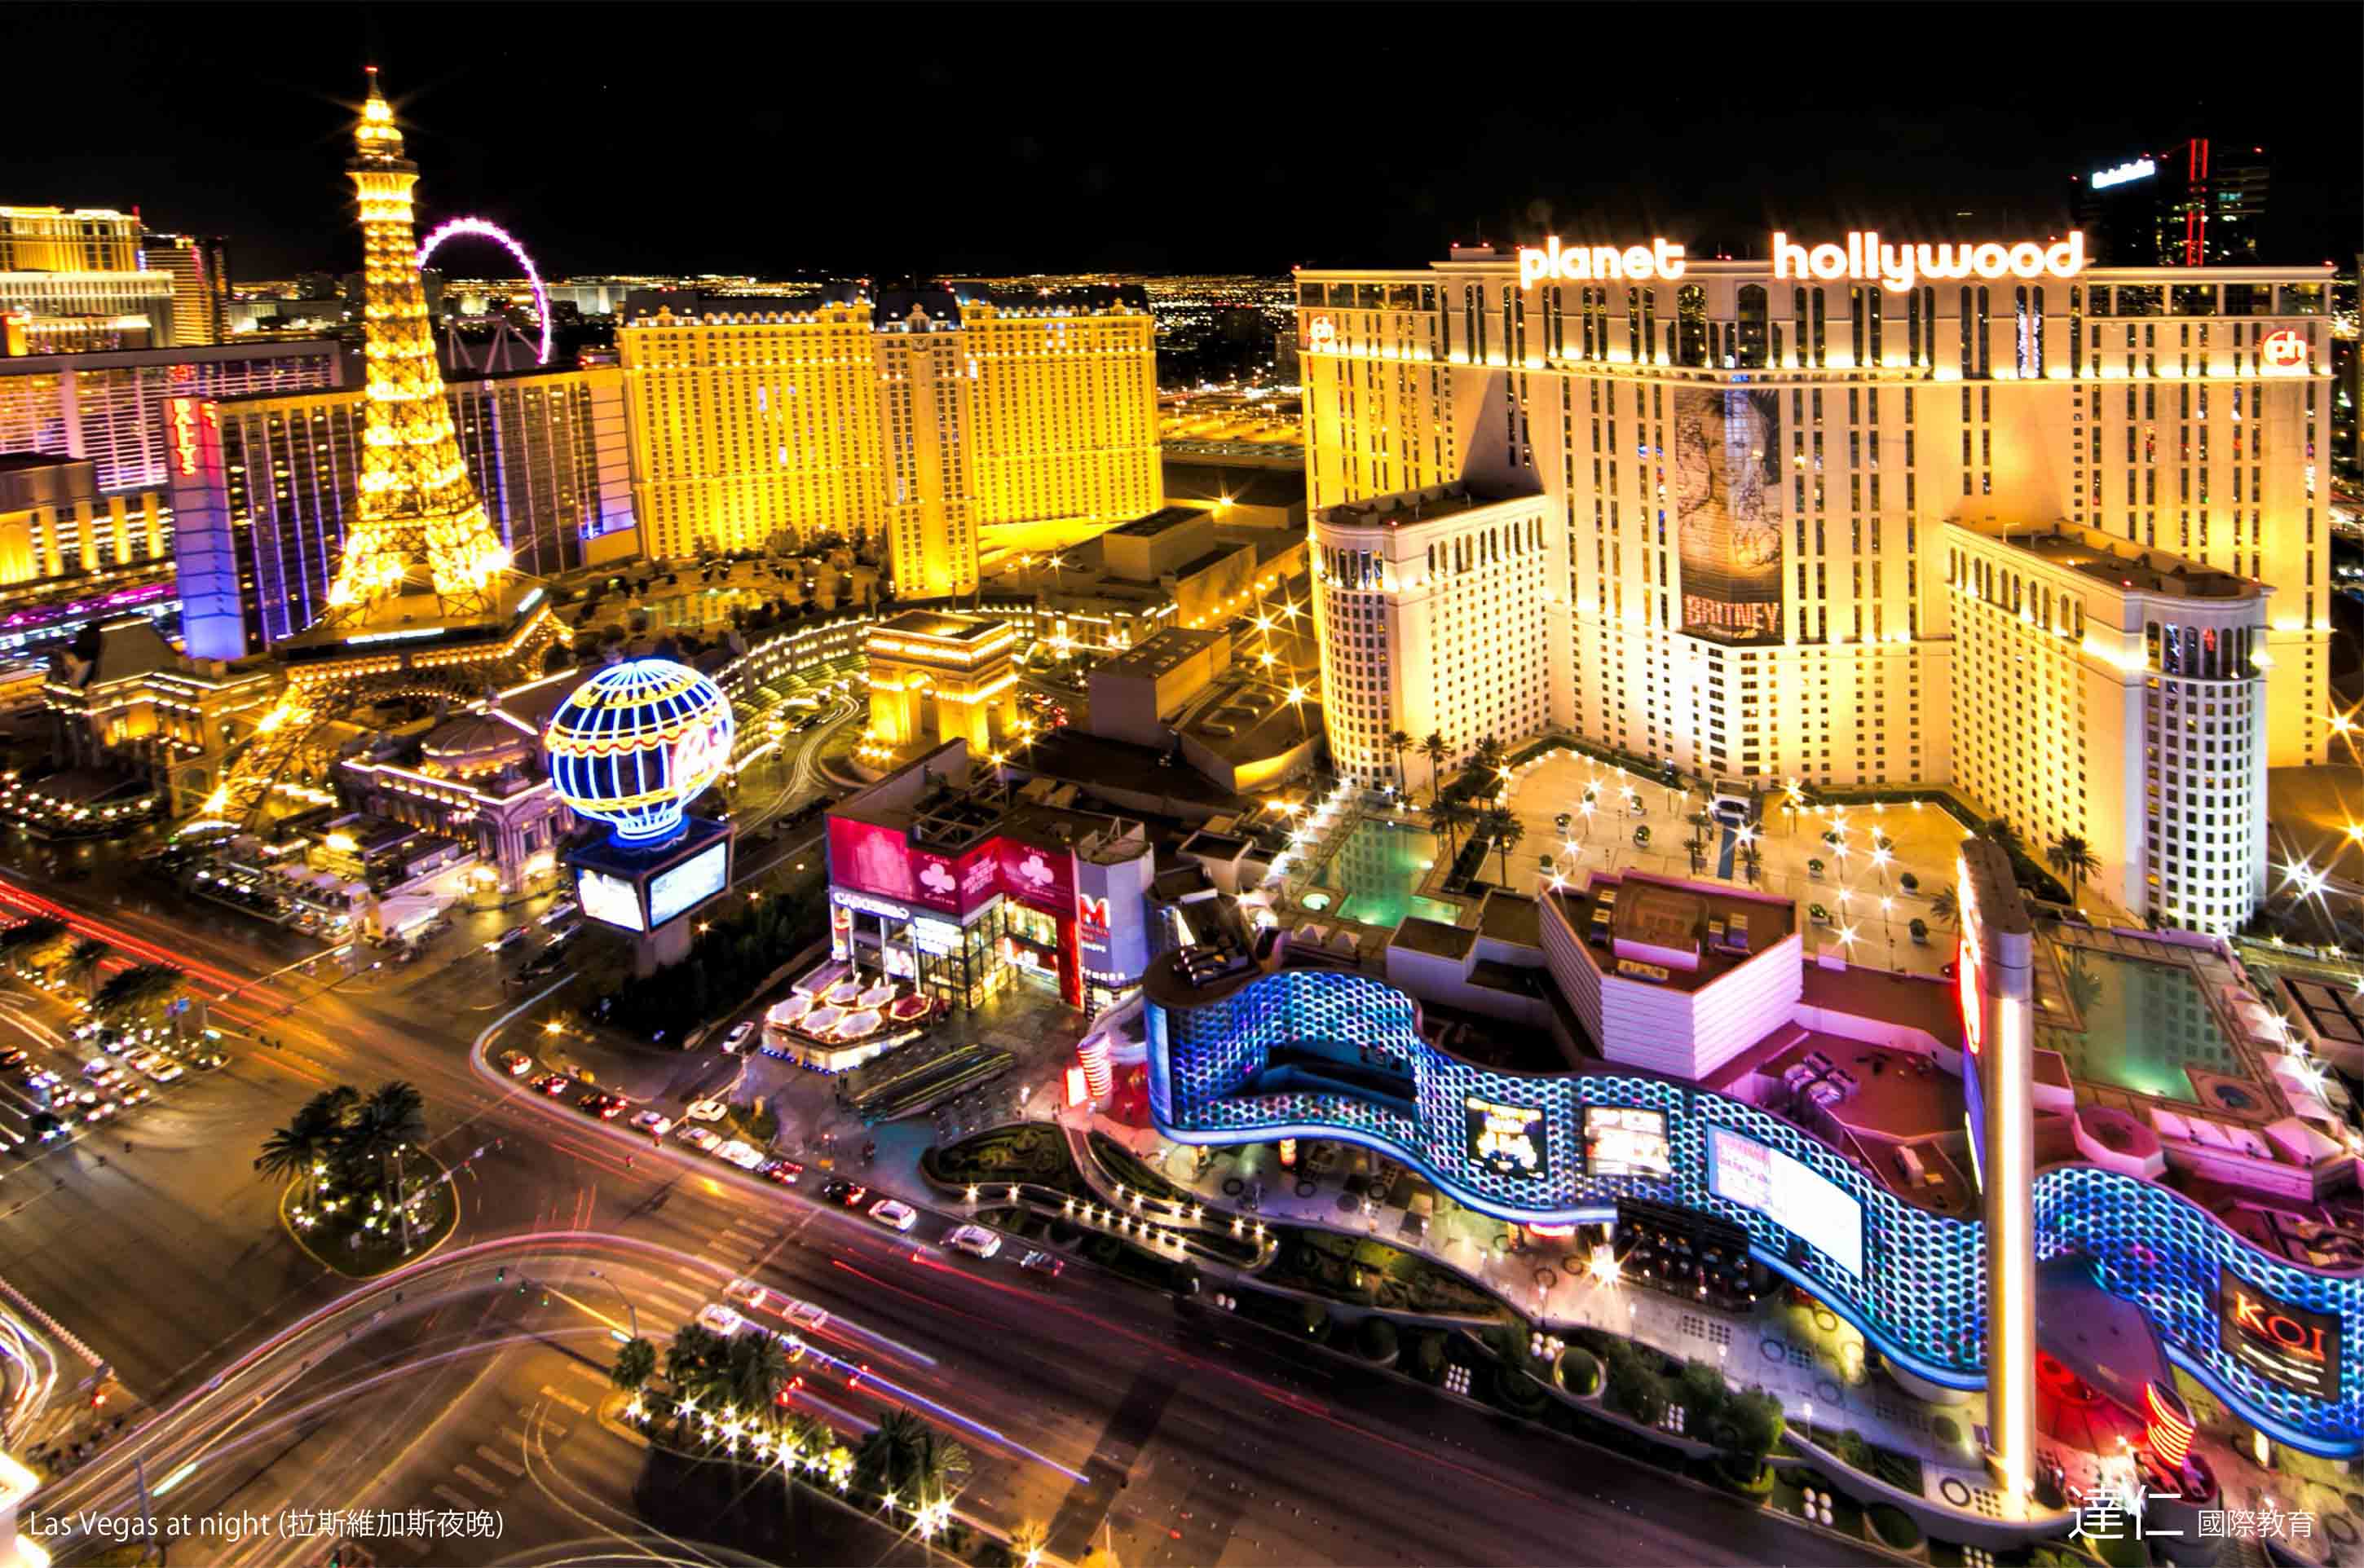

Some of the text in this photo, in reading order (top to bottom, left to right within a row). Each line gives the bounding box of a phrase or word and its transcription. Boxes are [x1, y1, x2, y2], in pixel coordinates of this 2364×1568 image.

[1519, 231, 2084, 292] planet hollywood
[1685, 595, 1780, 632] BRITNEY
[2233, 1291, 2326, 1362] KOI
